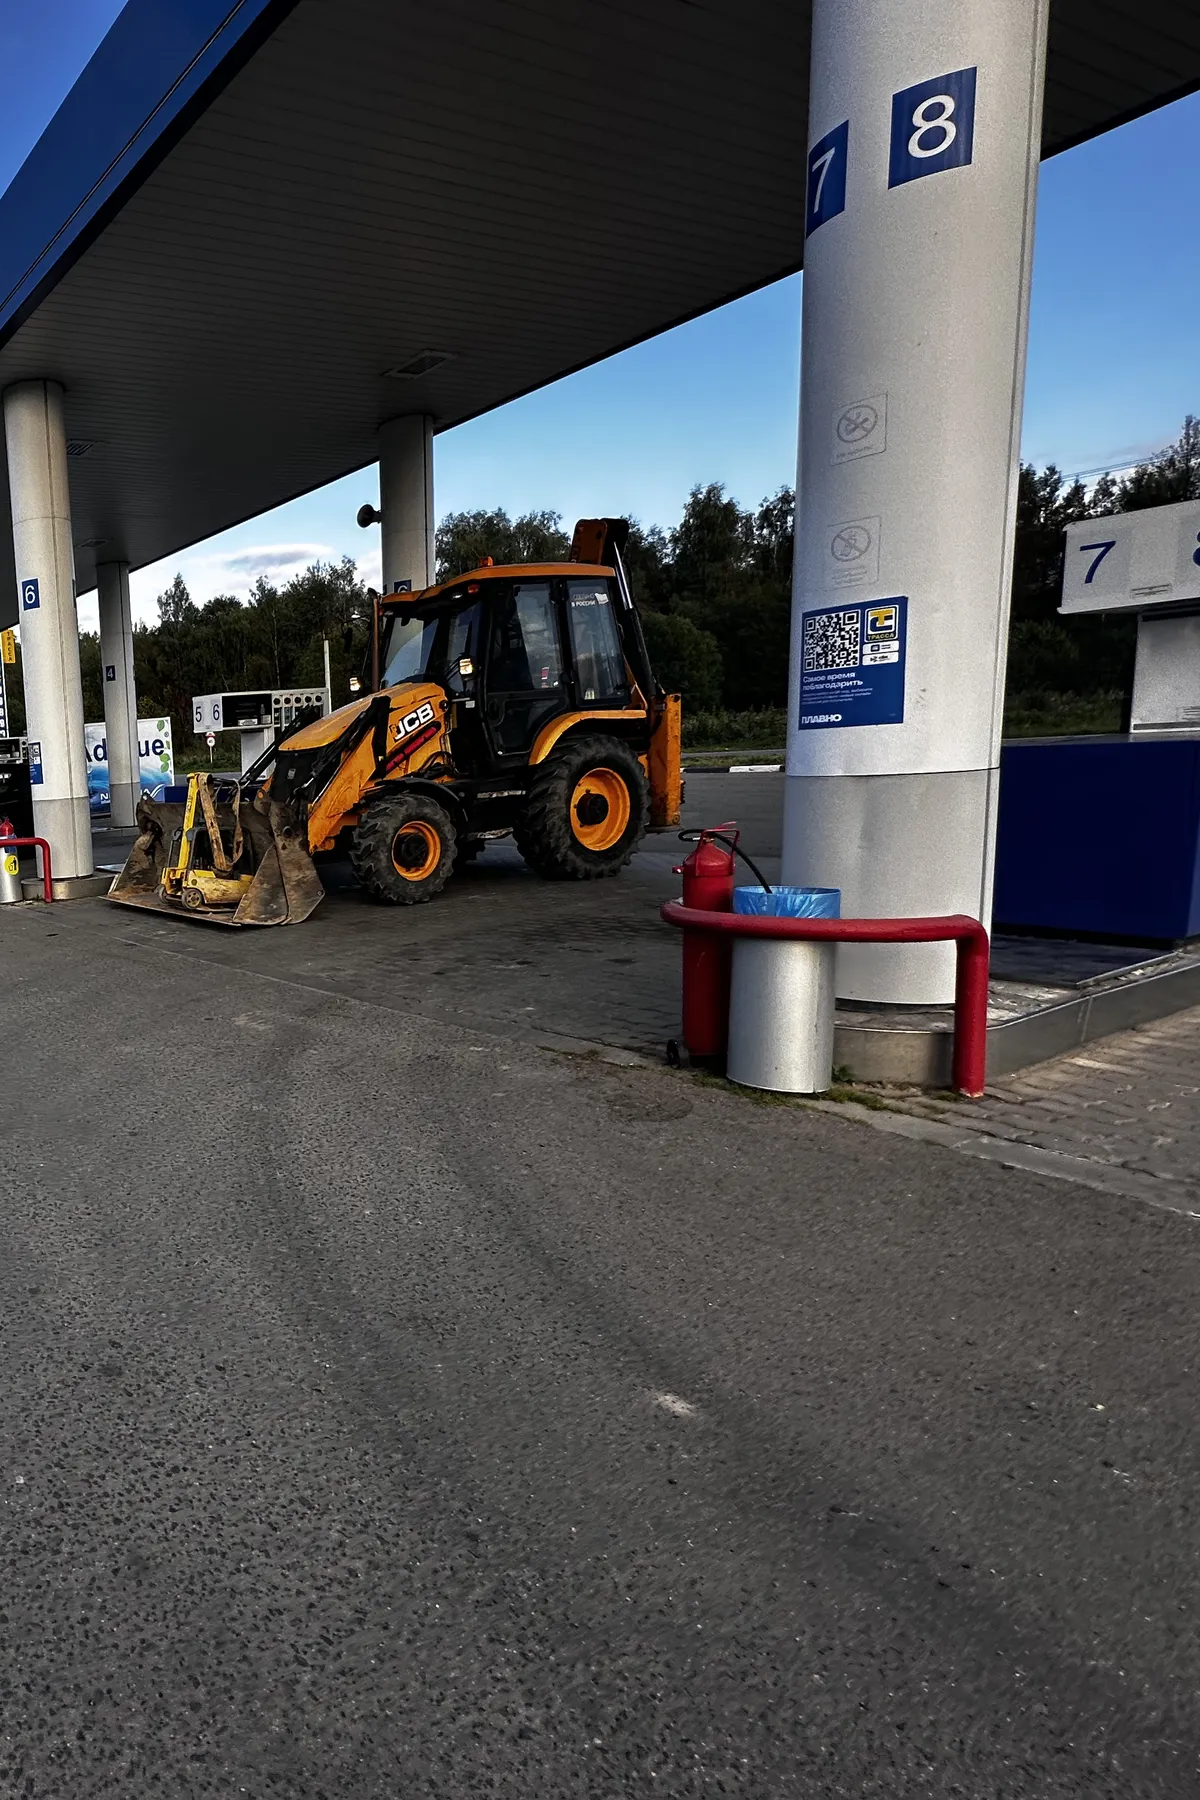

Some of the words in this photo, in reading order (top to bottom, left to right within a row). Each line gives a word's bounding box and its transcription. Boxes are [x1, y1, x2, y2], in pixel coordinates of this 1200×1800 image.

[907, 94, 958, 159] 8
[811, 146, 836, 214] 7
[1080, 540, 1117, 584] 7
[25, 585, 35, 604] 6
[867, 632, 895, 640] ТРАССА
[107, 668, 114, 678] 4
[827, 673, 856, 682] время
[195, 706, 202, 723] 5
[213, 704, 220, 721] 6
[394, 703, 434, 740] JCB
[801, 713, 842, 724] ПЛАВНО
